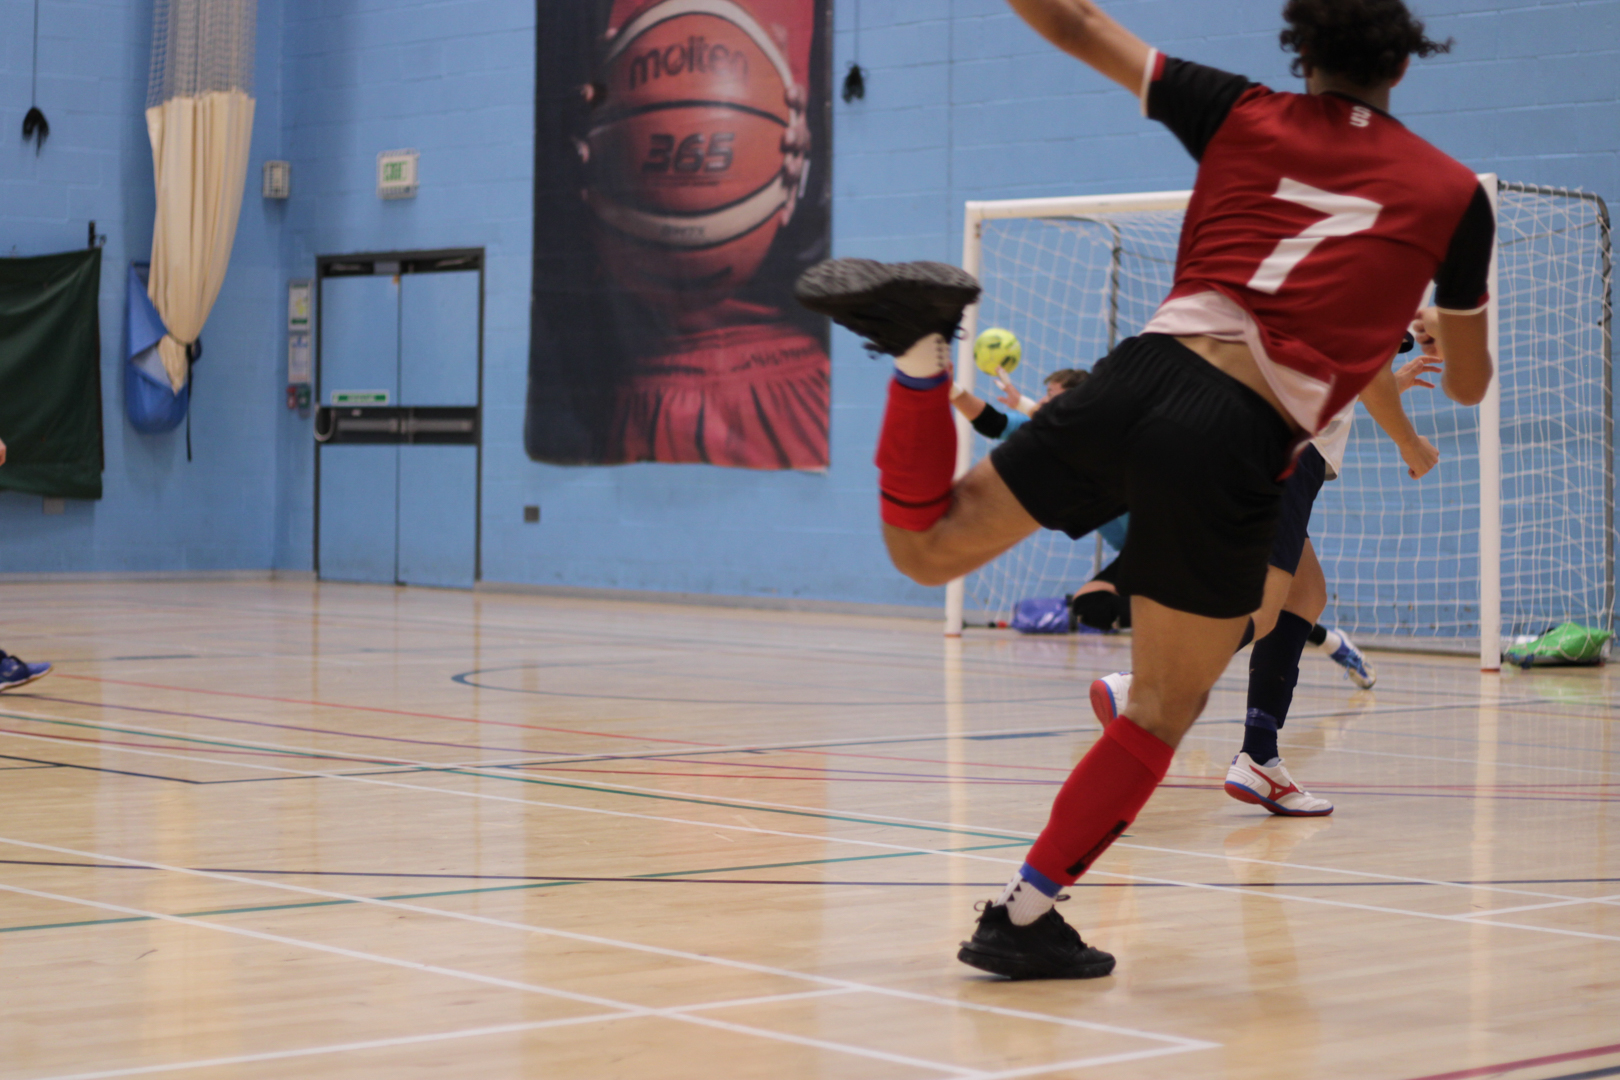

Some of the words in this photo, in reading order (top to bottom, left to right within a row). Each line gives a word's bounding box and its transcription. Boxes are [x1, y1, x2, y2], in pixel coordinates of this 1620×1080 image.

[629, 35, 749, 90] molten
[641, 131, 735, 173] 365
[1246, 176, 1384, 295] 7
